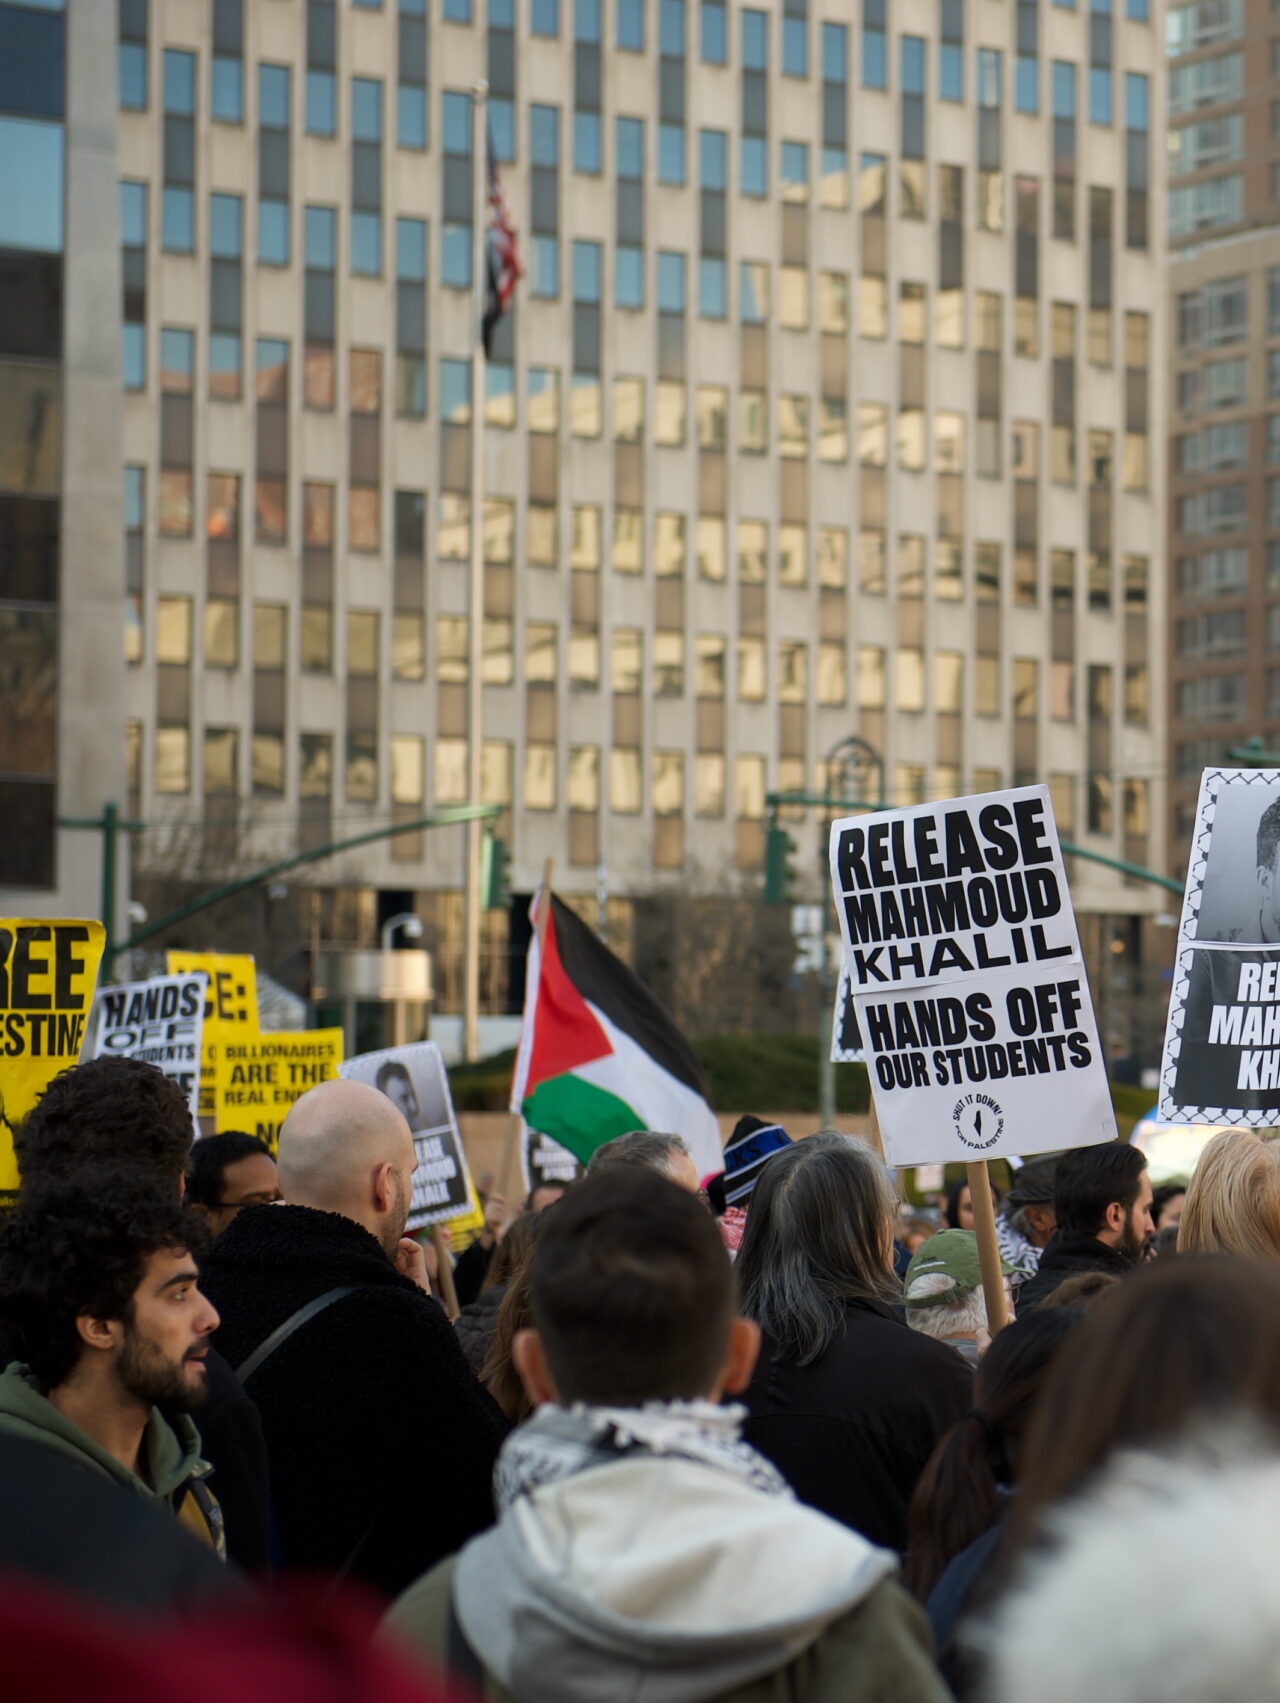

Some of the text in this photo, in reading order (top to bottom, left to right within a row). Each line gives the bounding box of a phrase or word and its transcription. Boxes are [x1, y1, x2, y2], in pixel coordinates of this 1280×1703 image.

[837, 798, 1054, 891] RELEASE
[843, 868, 1062, 945] MAHMOUD
[854, 925, 1073, 984] KHALIL
[104, 982, 200, 1028] HANDS
[866, 980, 1082, 1052] HANDS OFF
[104, 1021, 197, 1049] OFF
[226, 1044, 335, 1059] BILLIONAIRES
[231, 1063, 278, 1084] ARE
[287, 1062, 331, 1083] THE
[875, 1031, 1092, 1090] OUR STUDENTS
[225, 1090, 267, 1105] REAL
[953, 1093, 1003, 1121] SHUT IT DOWN!
[967, 1118, 1004, 1149] PALESTINE
